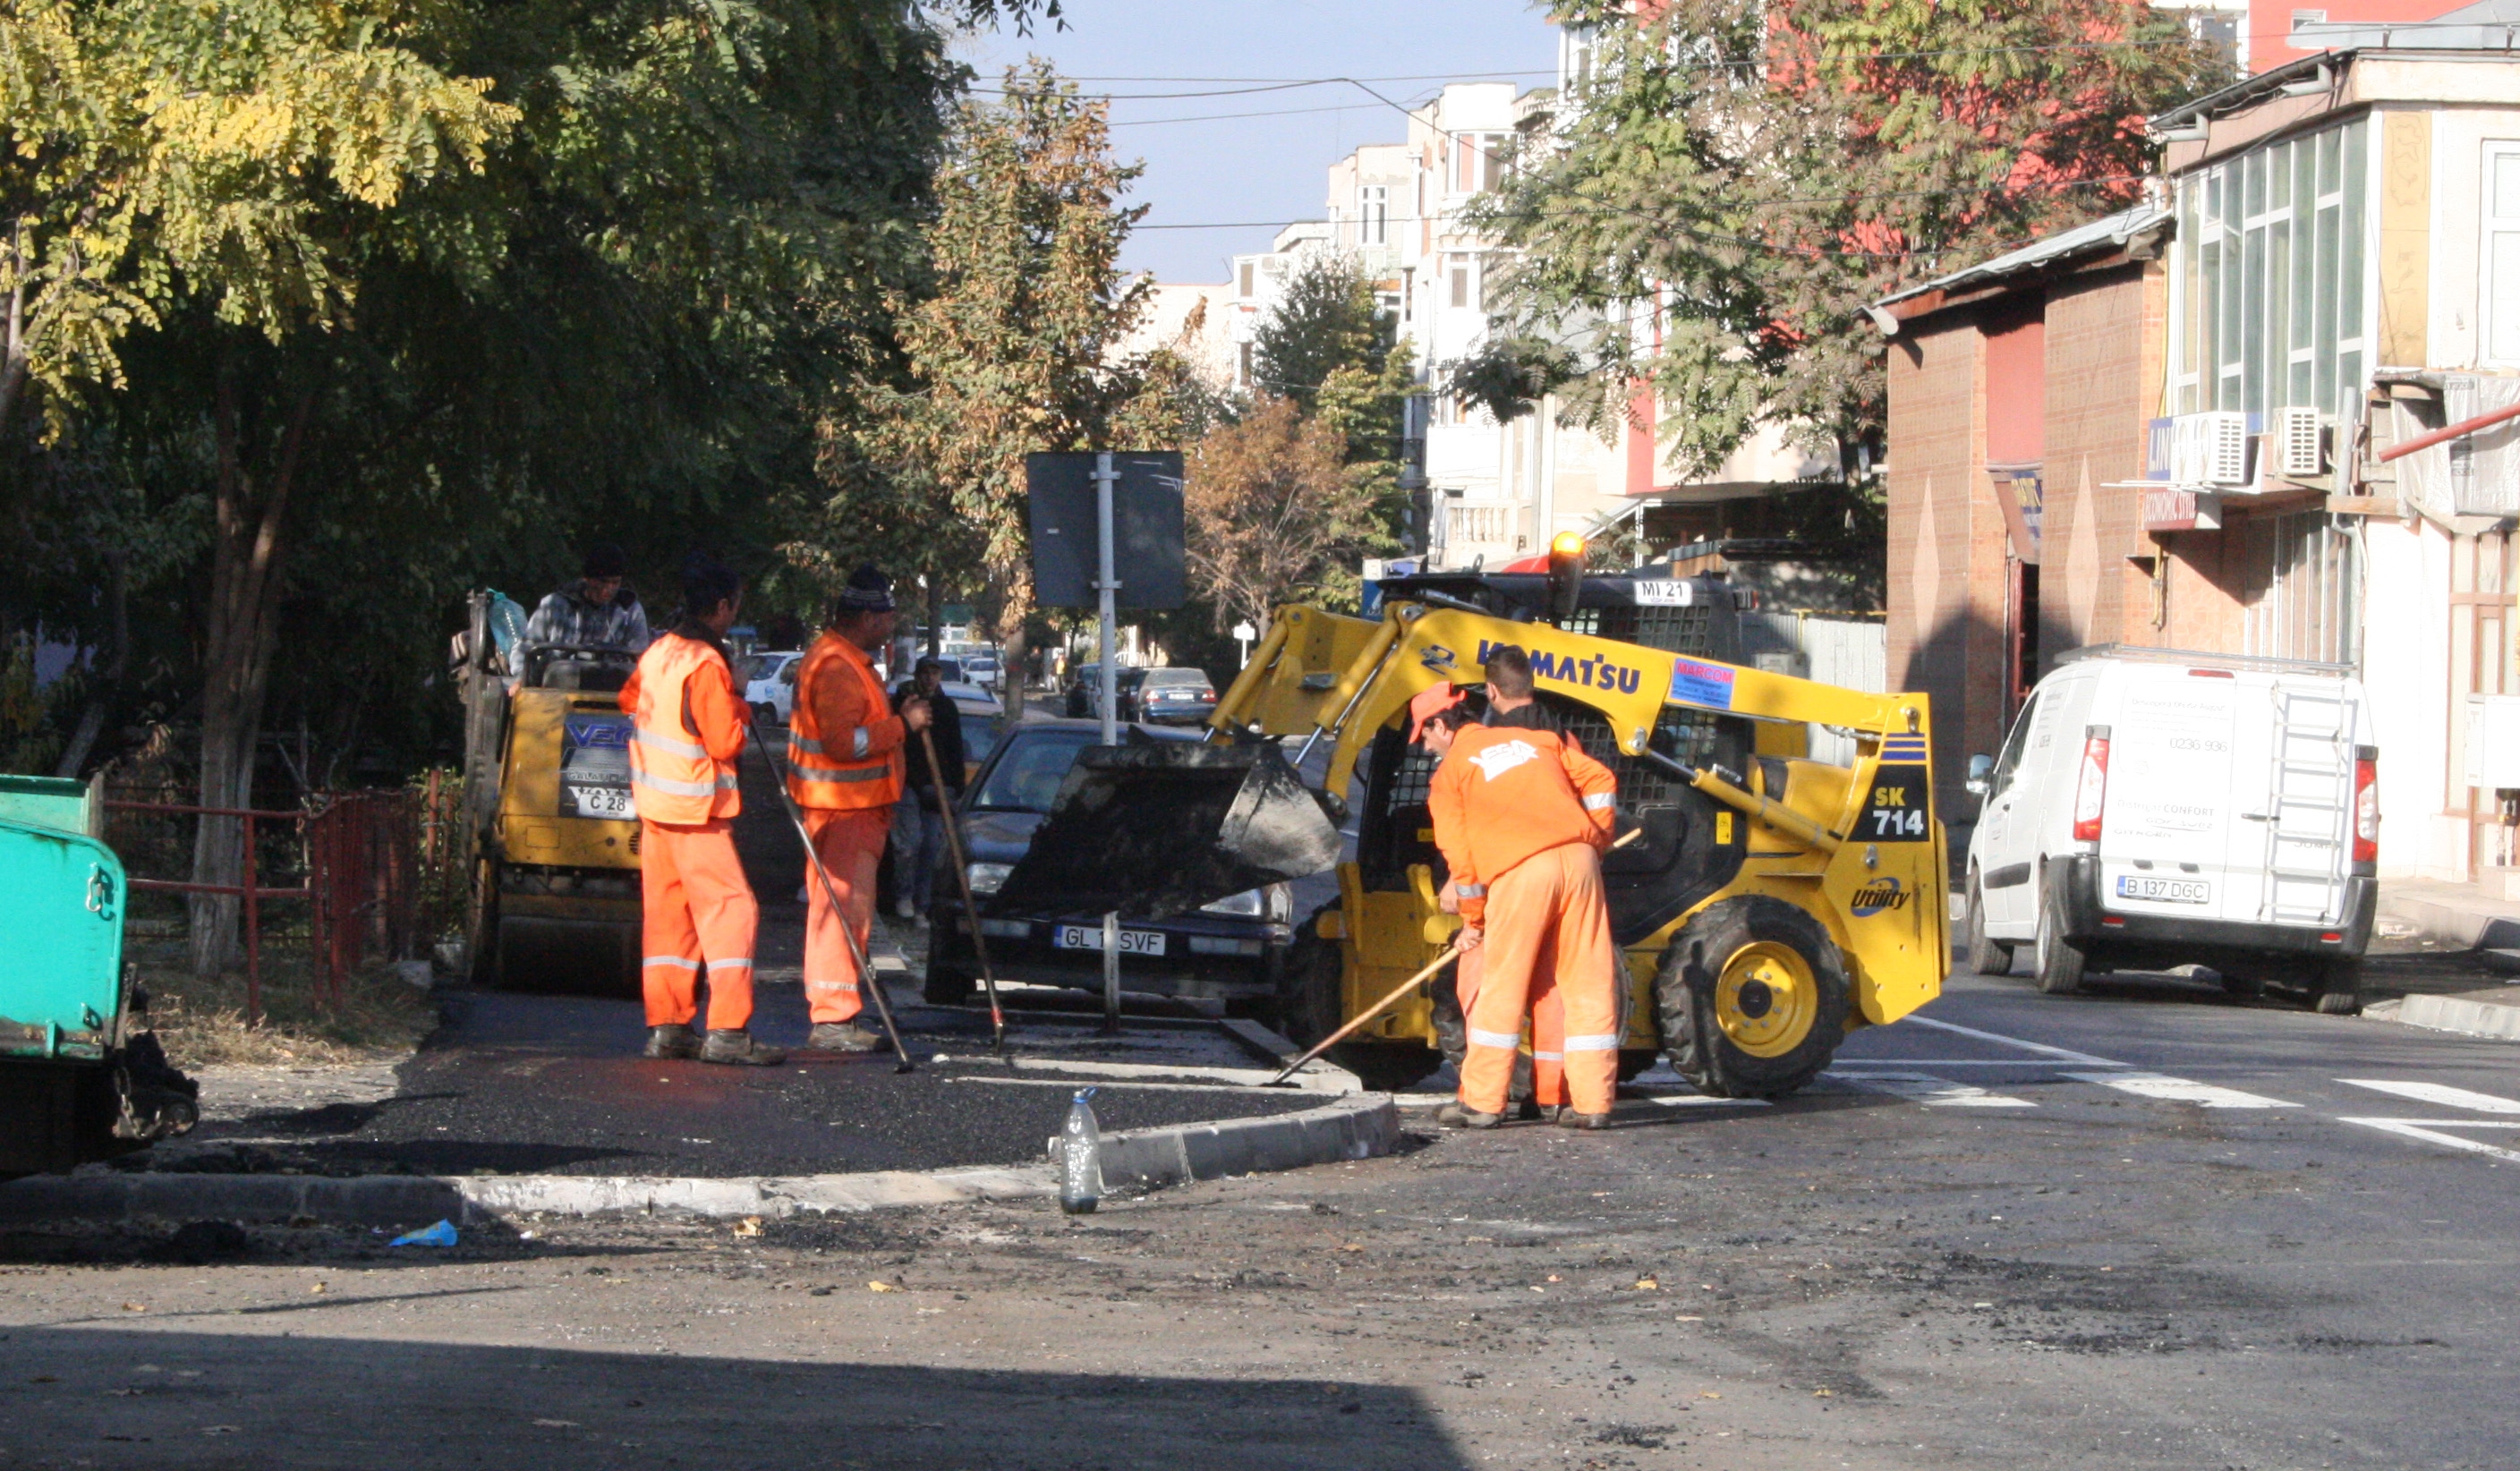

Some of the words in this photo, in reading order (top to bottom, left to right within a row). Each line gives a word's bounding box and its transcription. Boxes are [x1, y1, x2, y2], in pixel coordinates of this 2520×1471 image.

[2178, 491, 2196, 520] STYLE
[1642, 582, 1660, 596] MI
[1665, 582, 1682, 598] 21
[1477, 639, 1640, 694] KMATSU
[1677, 662, 1733, 684] MARCOM
[2204, 740, 2228, 752] 936
[590, 795, 600, 809] C
[607, 797, 626, 811] 28
[1875, 787, 1906, 806] SK
[2164, 804, 2215, 816] CONFORT
[1872, 809, 1924, 836] 714
[1851, 886, 1911, 910] Utility
[2127, 880, 2138, 893] B
[2144, 880, 2167, 896] 137
[2171, 882, 2204, 898] DGC
[1066, 929, 1090, 947] GL
[1120, 932, 1162, 951] SVF
